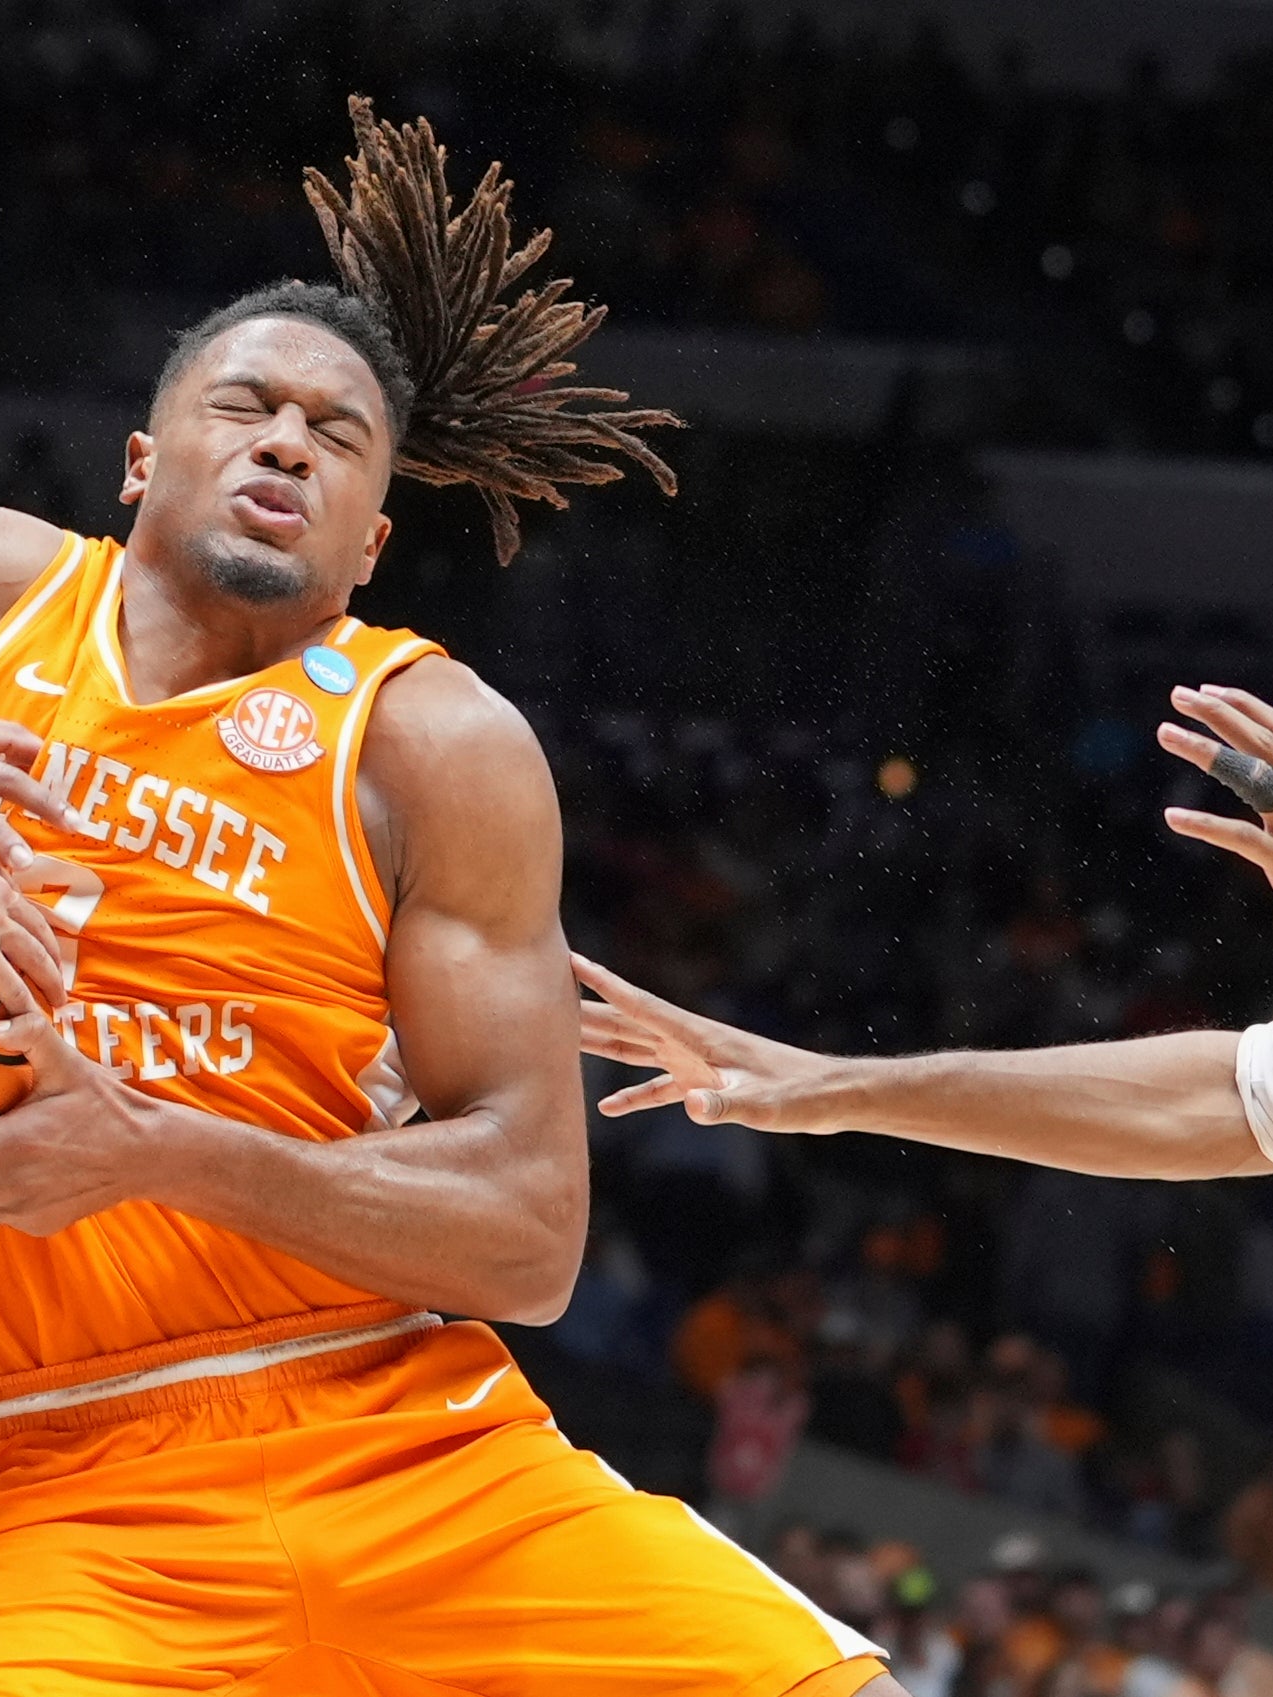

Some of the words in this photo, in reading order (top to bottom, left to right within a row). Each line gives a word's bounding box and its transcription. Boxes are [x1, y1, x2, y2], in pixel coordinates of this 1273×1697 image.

[307, 658, 350, 690] NCAA
[241, 692, 310, 749] SEC
[224, 733, 306, 771] GRADUATE
[53, 1000, 257, 1081] TEERS
